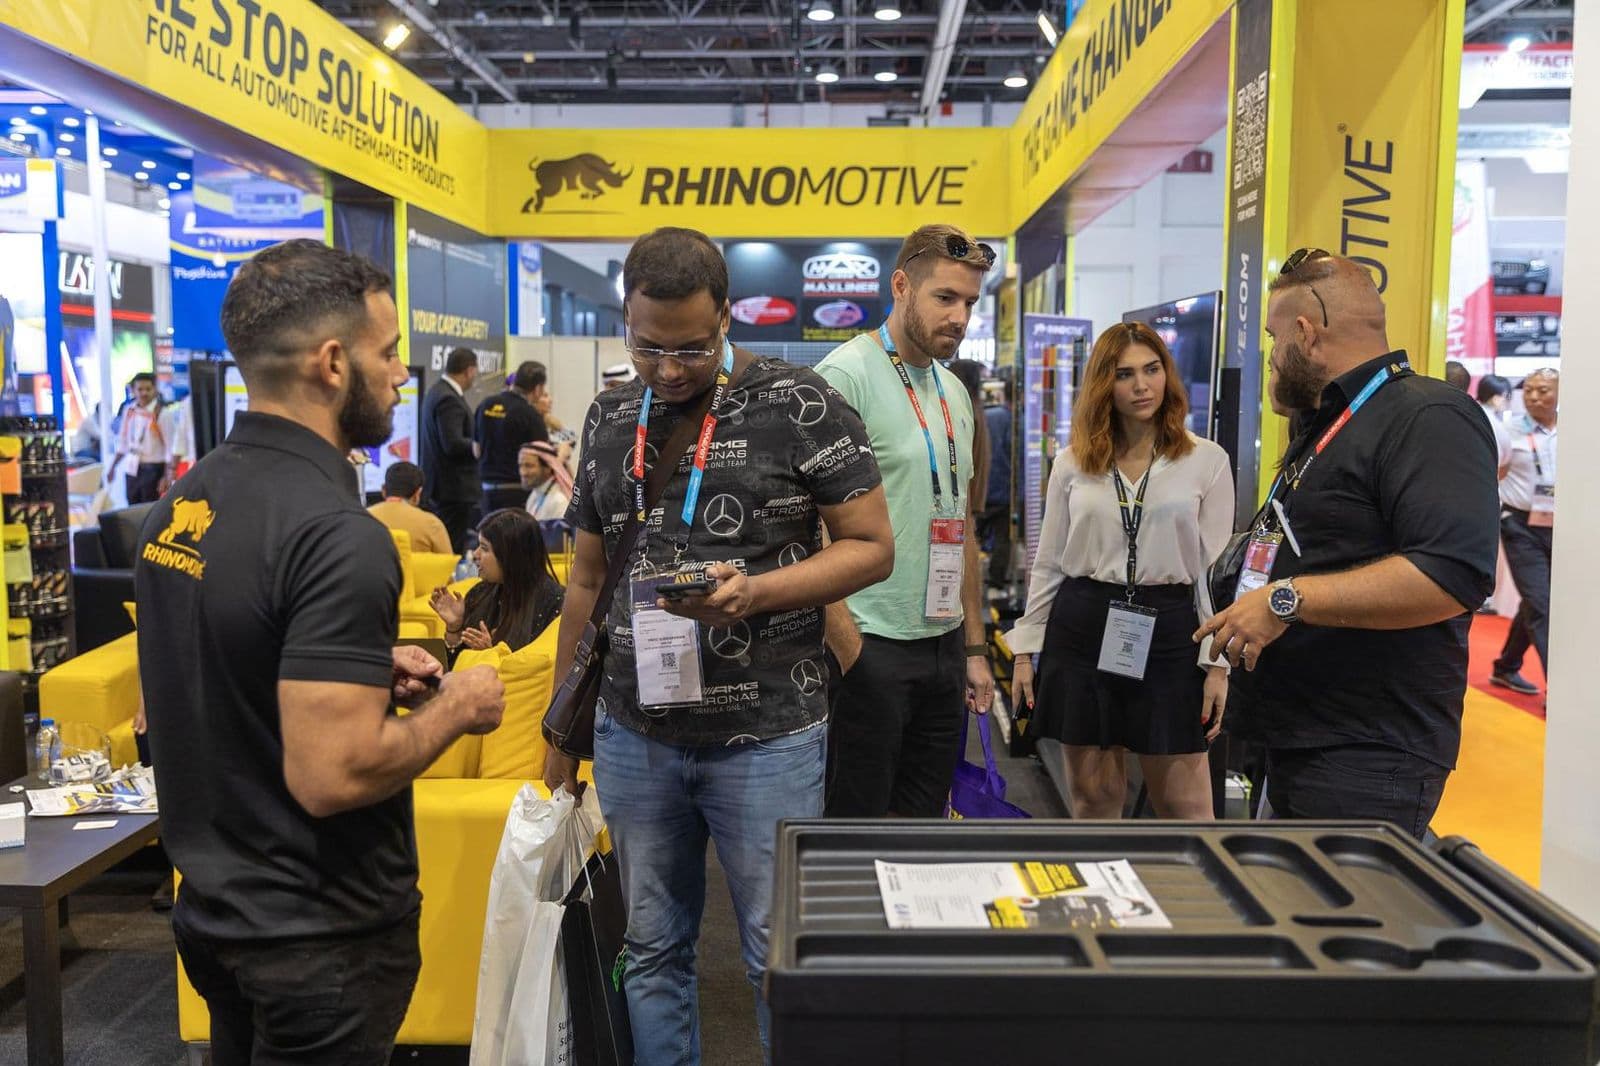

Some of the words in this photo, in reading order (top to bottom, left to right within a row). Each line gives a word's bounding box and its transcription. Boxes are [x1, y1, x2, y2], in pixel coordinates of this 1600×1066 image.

[1081, 0, 1172, 113] CHANG
[209, 0, 309, 85] STOP
[317, 48, 439, 164] SOLUTION
[146, 13, 187, 64] FOR
[192, 41, 226, 83] ALL
[231, 62, 329, 134] AUTOMOTIVE
[332, 116, 409, 174] AFTERMARKET
[412, 157, 456, 196] PRODUCTS
[639, 165, 969, 207] RHINOMOTIVE
[803, 281, 880, 294] MAXLINER
[817, 435, 852, 462] AMG
[727, 459, 747, 468] TEAM
[759, 613, 819, 639] PETRONAS
[712, 681, 759, 695] AMG
